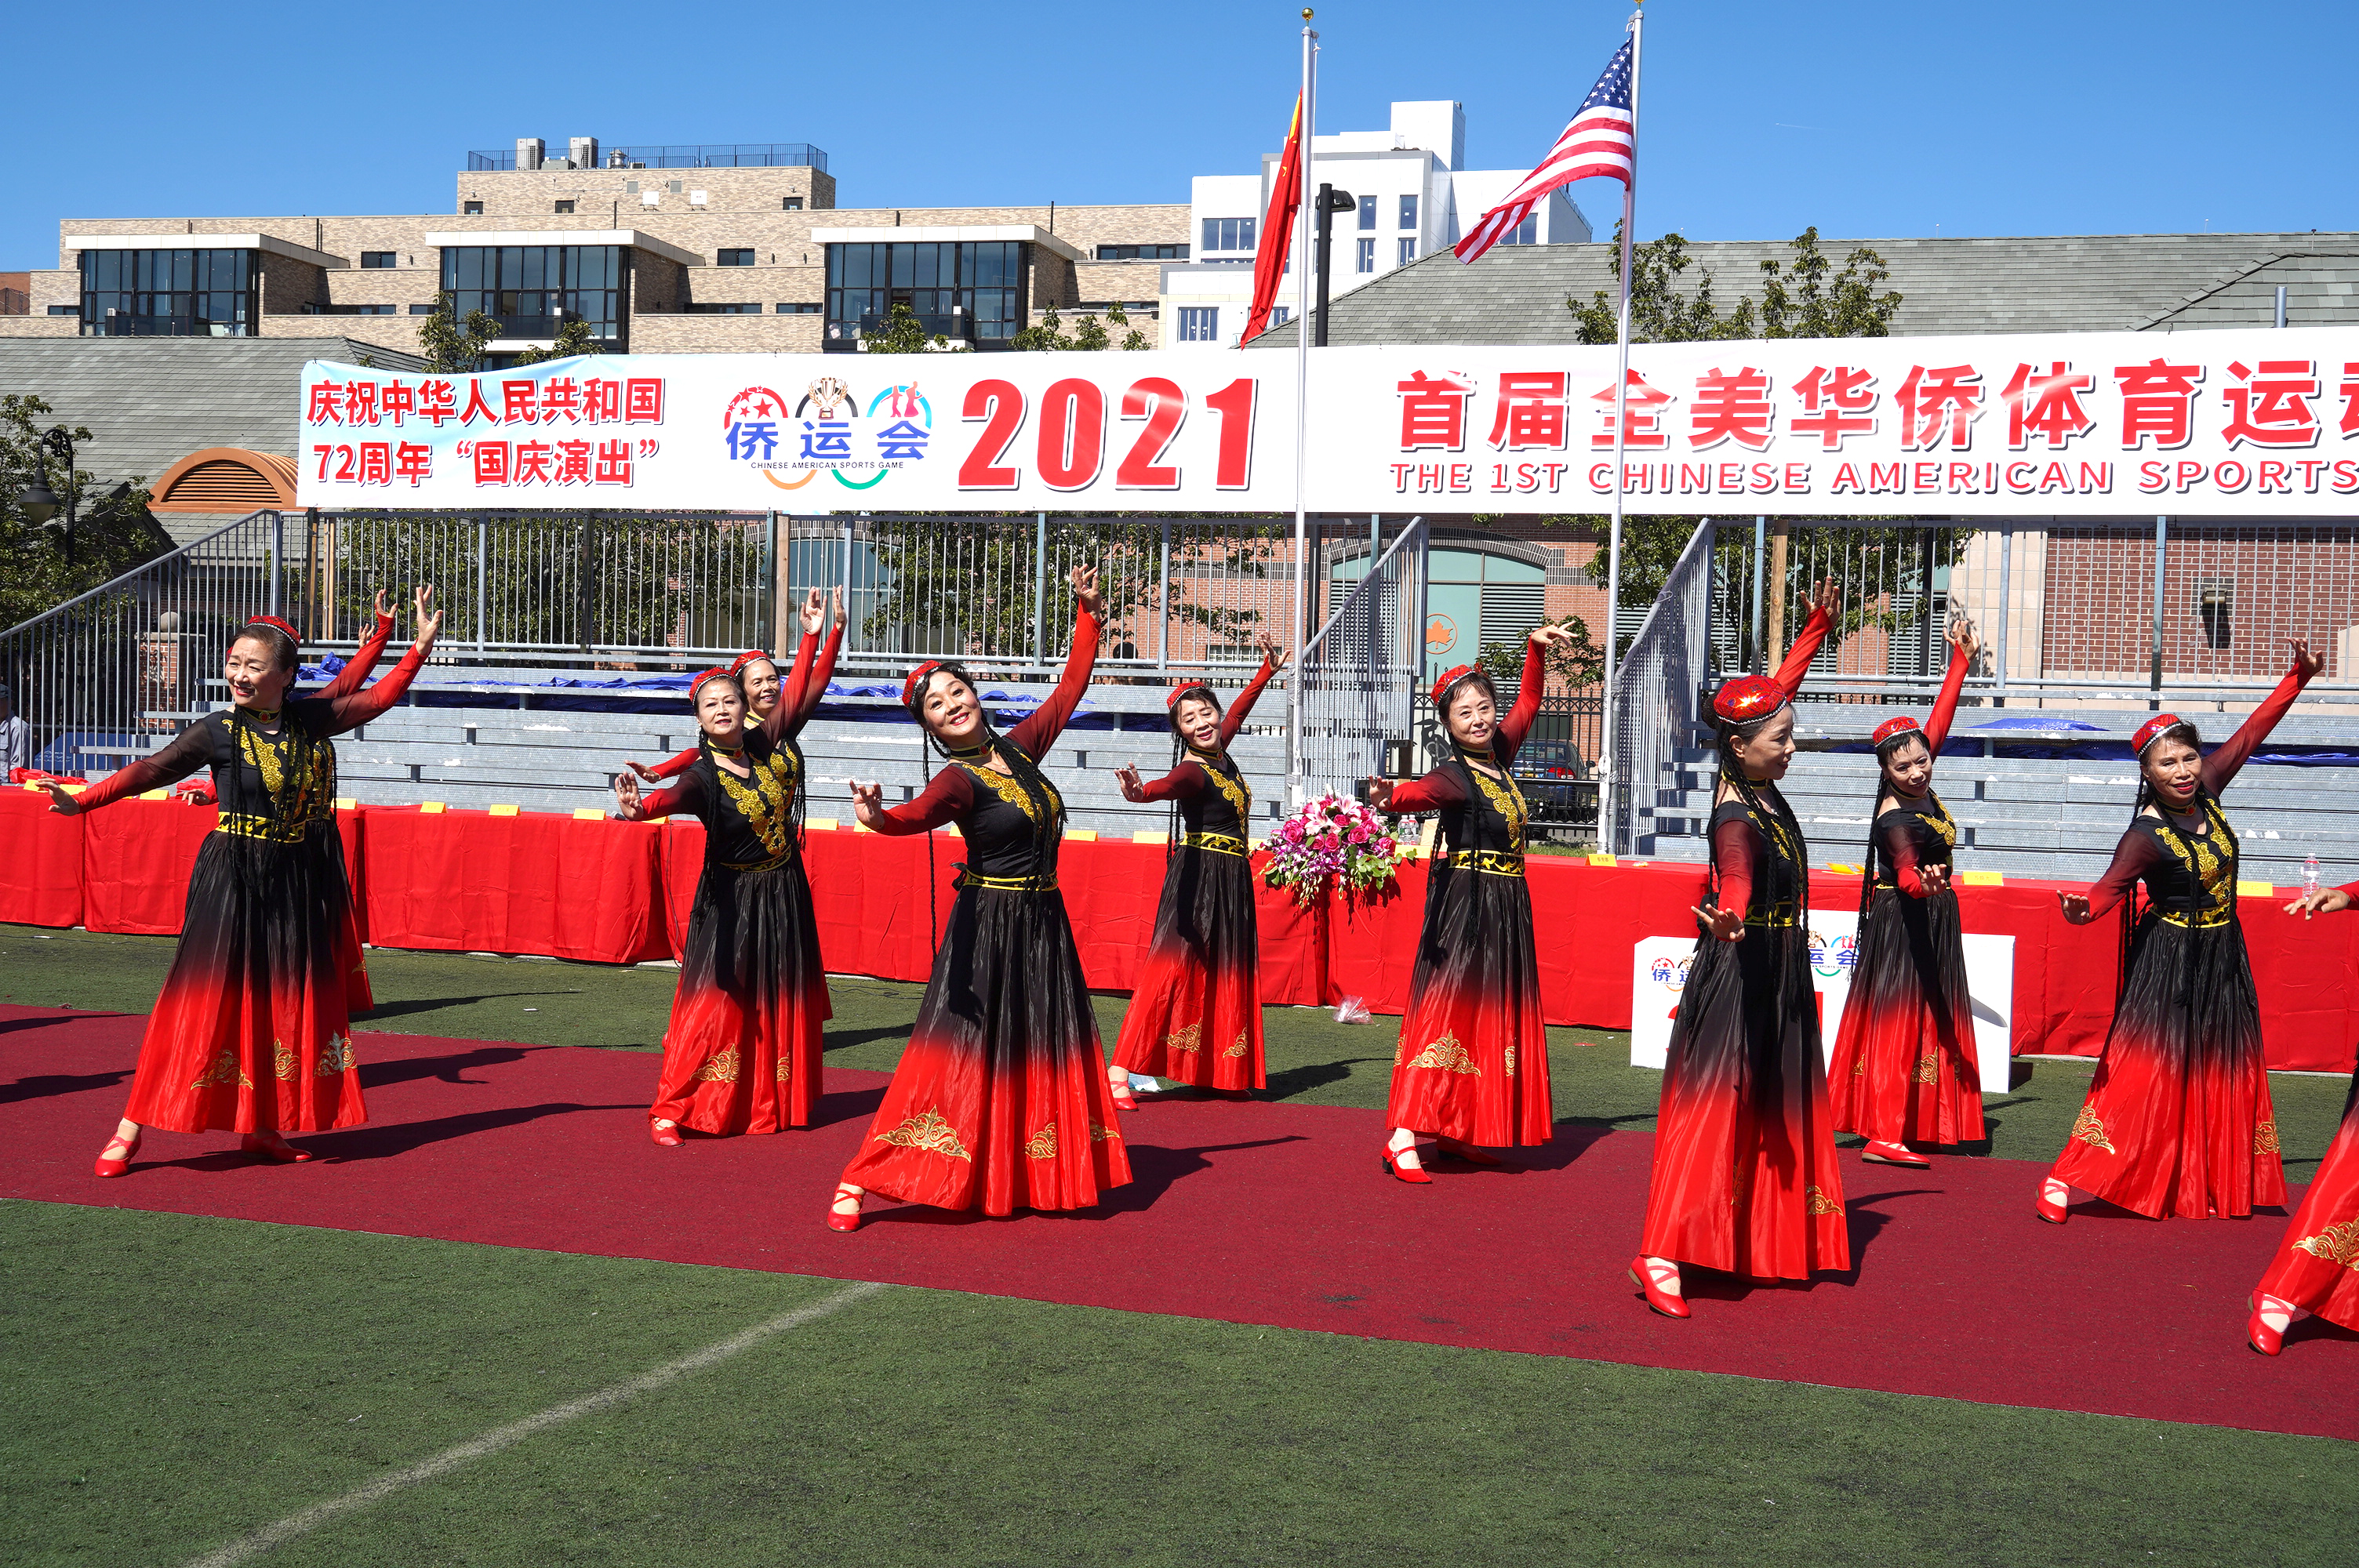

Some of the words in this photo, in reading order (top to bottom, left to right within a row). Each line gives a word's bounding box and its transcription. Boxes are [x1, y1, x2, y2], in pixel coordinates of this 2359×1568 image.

[307, 377, 663, 426] 庆祝中华人民共和国
[1397, 358, 2359, 449] 首届全美华侨体育运
[725, 420, 931, 461] 侨运会
[958, 376, 1256, 489] 2021
[1390, 463, 1470, 491] THE
[1490, 463, 1565, 490] 1ST
[1588, 462, 1808, 490] CHINESE
[1831, 460, 2110, 490] AMERICAN
[2139, 459, 2359, 490] SPORTS
